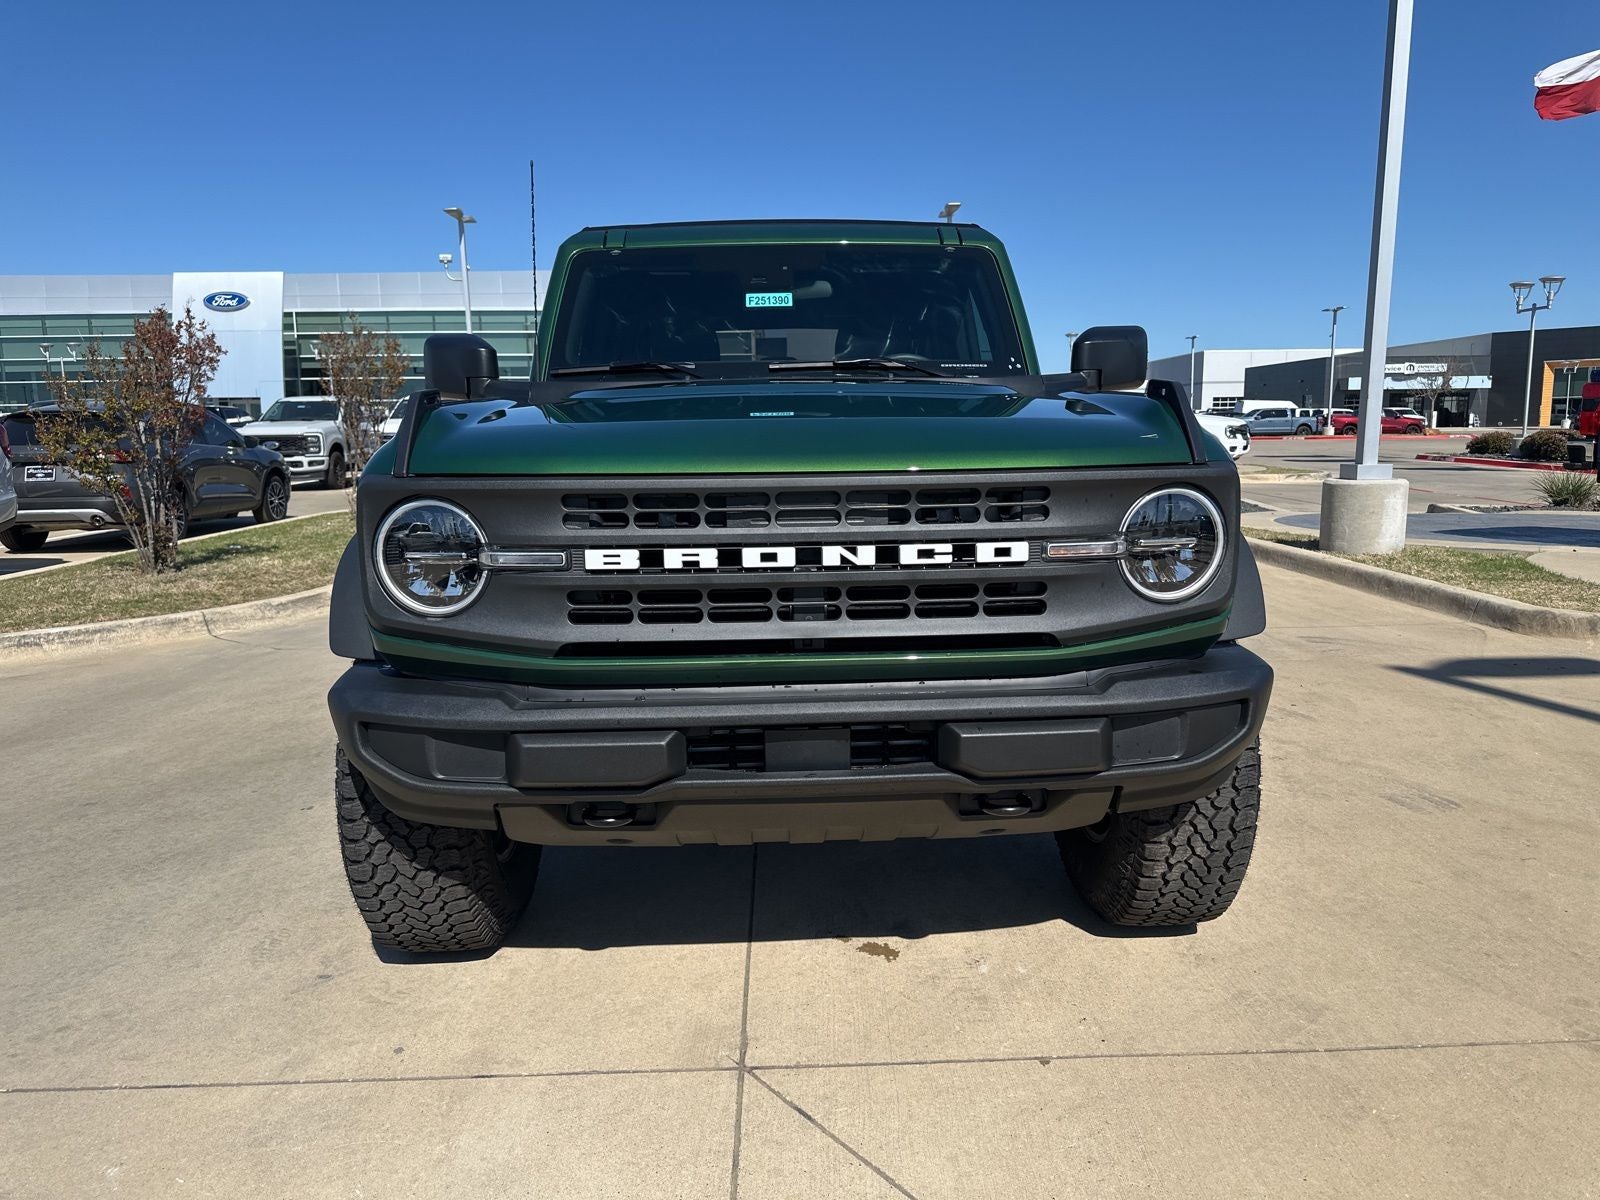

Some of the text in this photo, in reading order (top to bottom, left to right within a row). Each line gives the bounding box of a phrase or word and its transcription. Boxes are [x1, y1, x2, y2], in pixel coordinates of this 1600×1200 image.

[212, 295, 239, 306] Ford
[748, 295, 790, 305] F251390
[584, 541, 1030, 571] BRONCO
